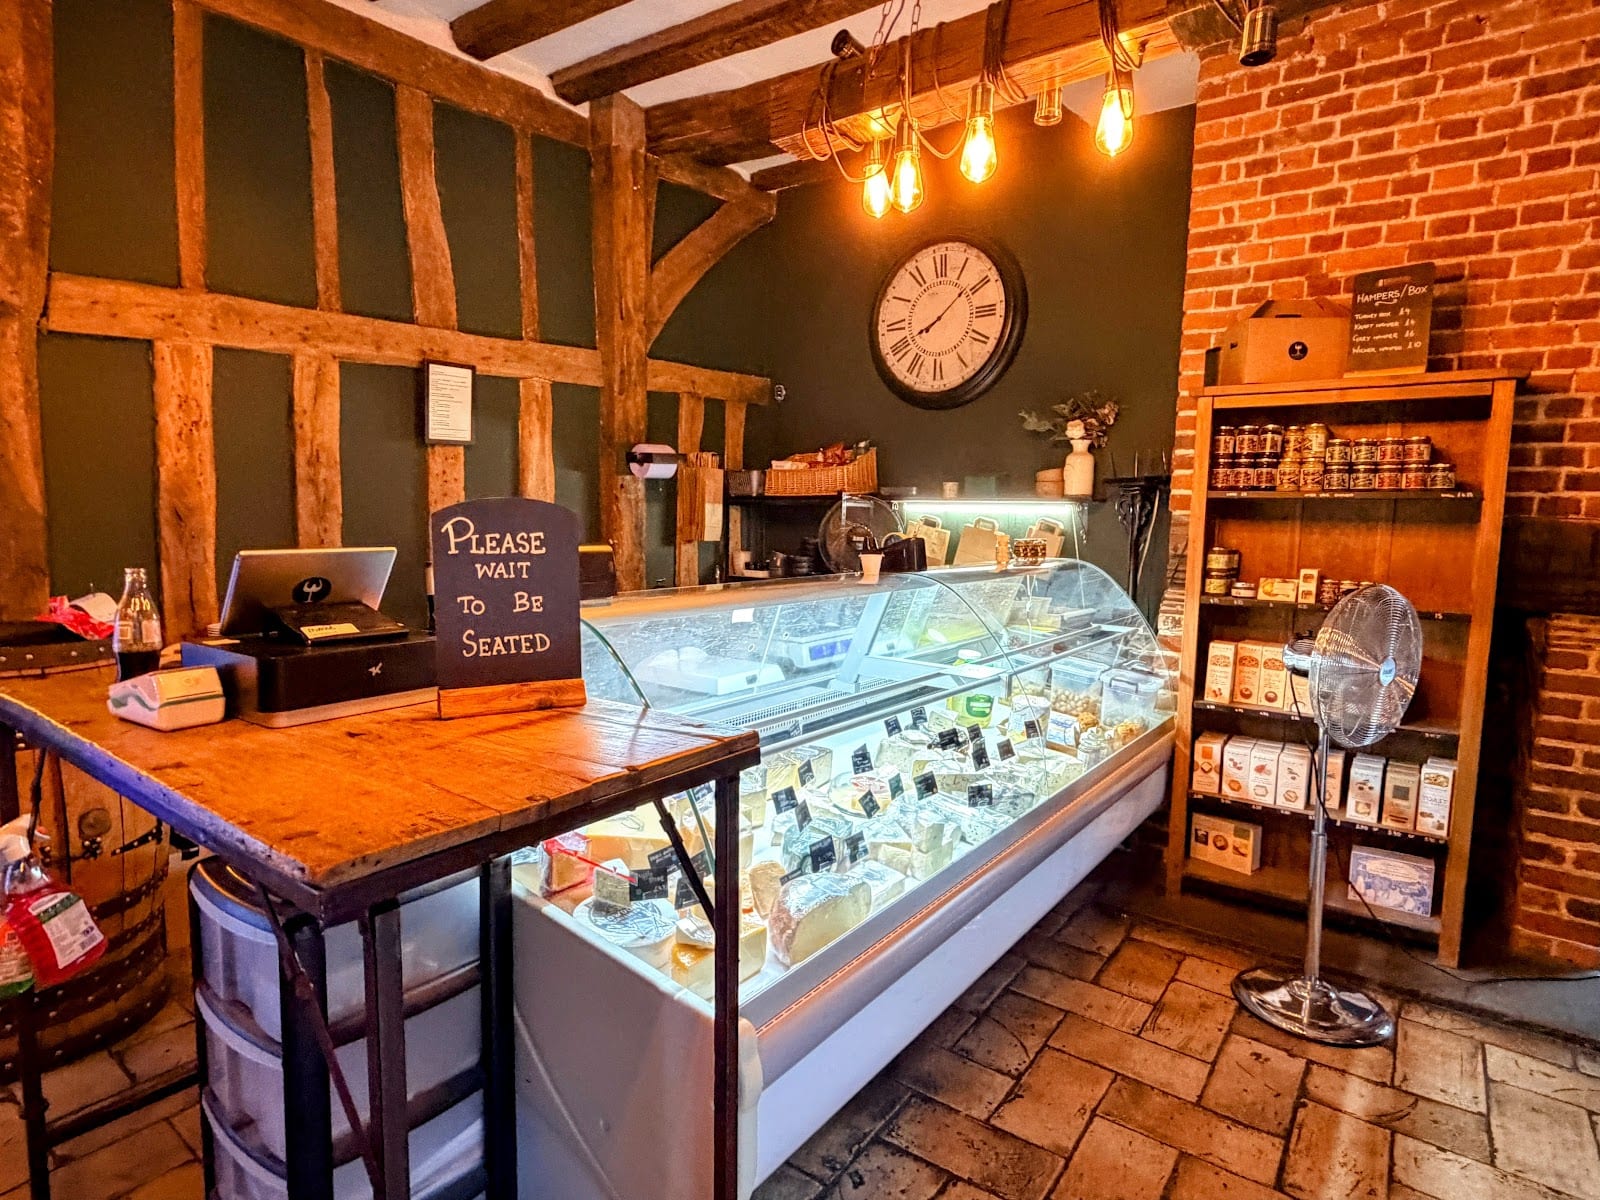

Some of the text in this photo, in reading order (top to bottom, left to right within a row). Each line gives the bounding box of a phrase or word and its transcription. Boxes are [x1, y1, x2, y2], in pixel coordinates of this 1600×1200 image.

[441, 516, 546, 555] PLEASE
[474, 561, 531, 580] WAIT
[456, 591, 544, 615] TO BE
[462, 629, 551, 658] SEATED
